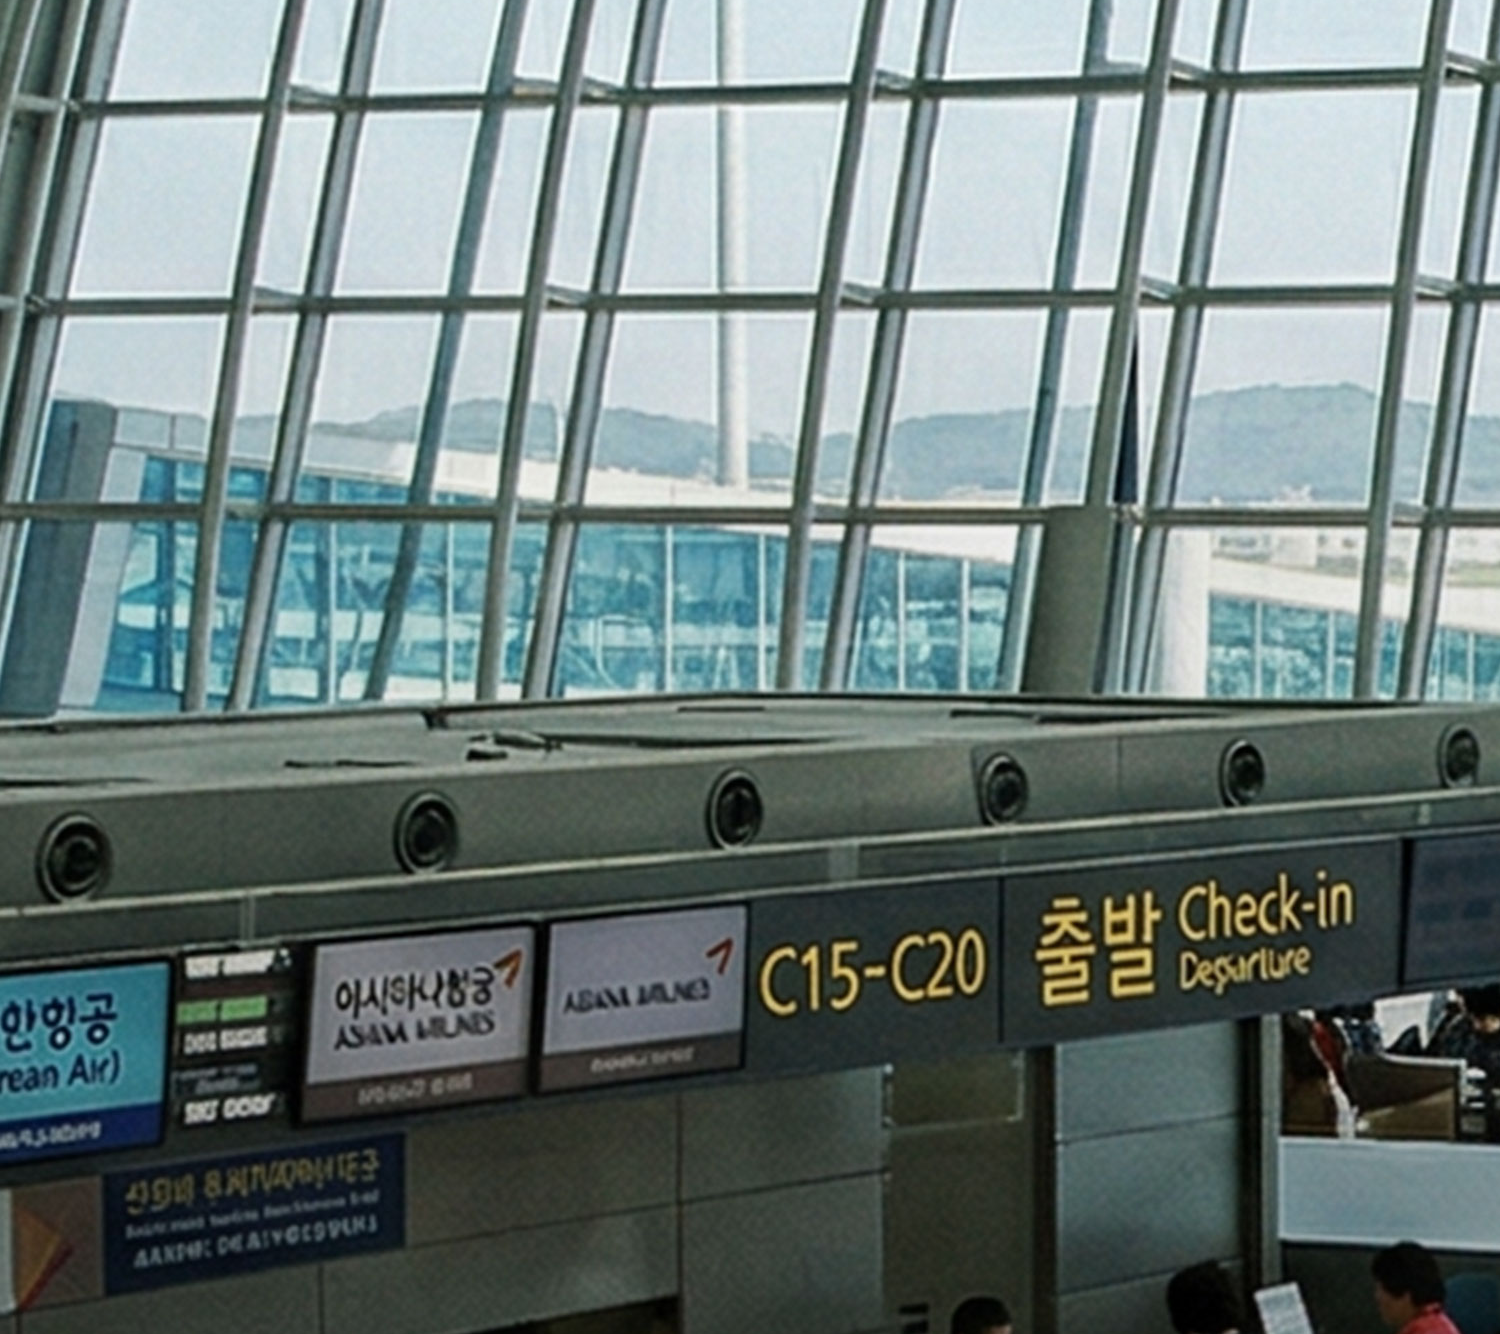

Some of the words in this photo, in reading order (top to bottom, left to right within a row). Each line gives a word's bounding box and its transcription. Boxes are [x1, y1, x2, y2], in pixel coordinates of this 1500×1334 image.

[1035, 891, 1162, 1008] 출발
[1177, 870, 1354, 943] Check-in
[759, 928, 986, 1017] C15-C20
